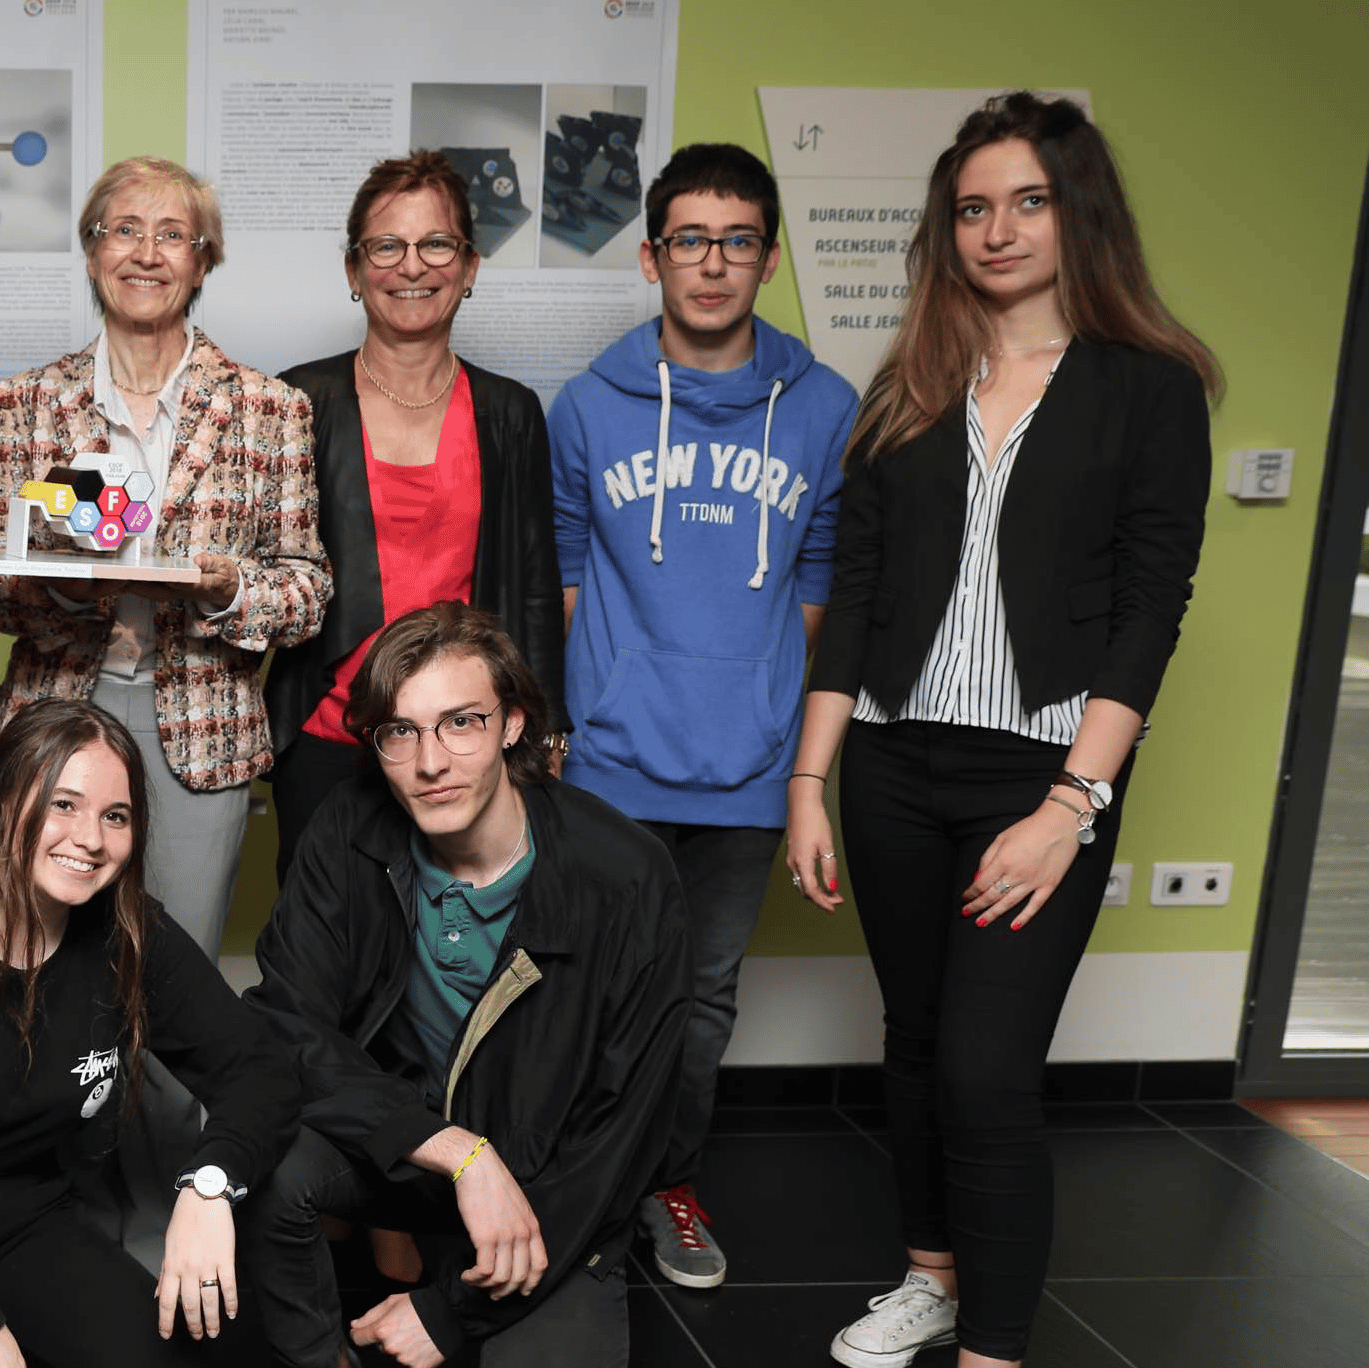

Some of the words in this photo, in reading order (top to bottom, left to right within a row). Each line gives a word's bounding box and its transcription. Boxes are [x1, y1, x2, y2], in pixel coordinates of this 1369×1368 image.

[809, 208, 875, 222] BUREAUX
[815, 239, 896, 253] ASCENSEUR
[824, 285, 866, 299] SALLE
[869, 285, 889, 299] DU
[892, 284, 910, 299] CO
[831, 315, 871, 328] SALLE
[874, 314, 903, 328] JEA
[603, 442, 698, 510] NEW
[709, 442, 808, 521] YORK
[55, 489, 68, 510] E
[107, 490, 120, 511] F
[80, 507, 93, 527] S
[102, 523, 119, 541] O
